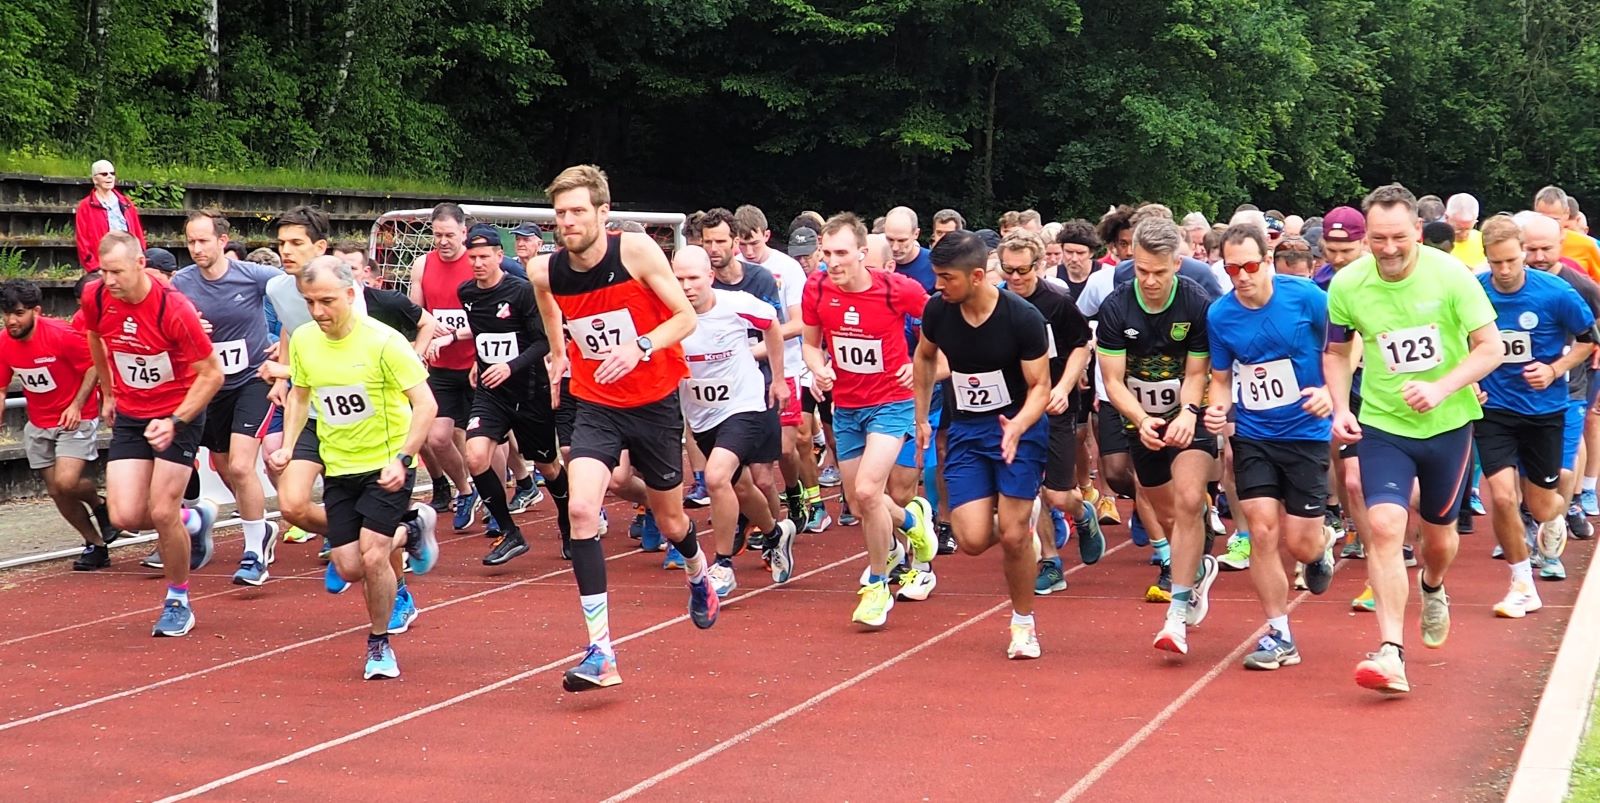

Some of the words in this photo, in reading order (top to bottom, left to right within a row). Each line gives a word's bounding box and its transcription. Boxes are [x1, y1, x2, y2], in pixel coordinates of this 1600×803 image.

[481, 341, 512, 357] 177
[585, 328, 621, 353] 917
[1386, 336, 1436, 364] 123
[219, 347, 241, 367] 17
[838, 346, 878, 366] 104
[18, 373, 49, 387] 144
[128, 366, 161, 383] 745
[692, 385, 730, 402] 102
[967, 389, 992, 405] 22
[1133, 386, 1176, 406] 119
[1250, 379, 1284, 402] 910
[324, 394, 366, 416] 189
